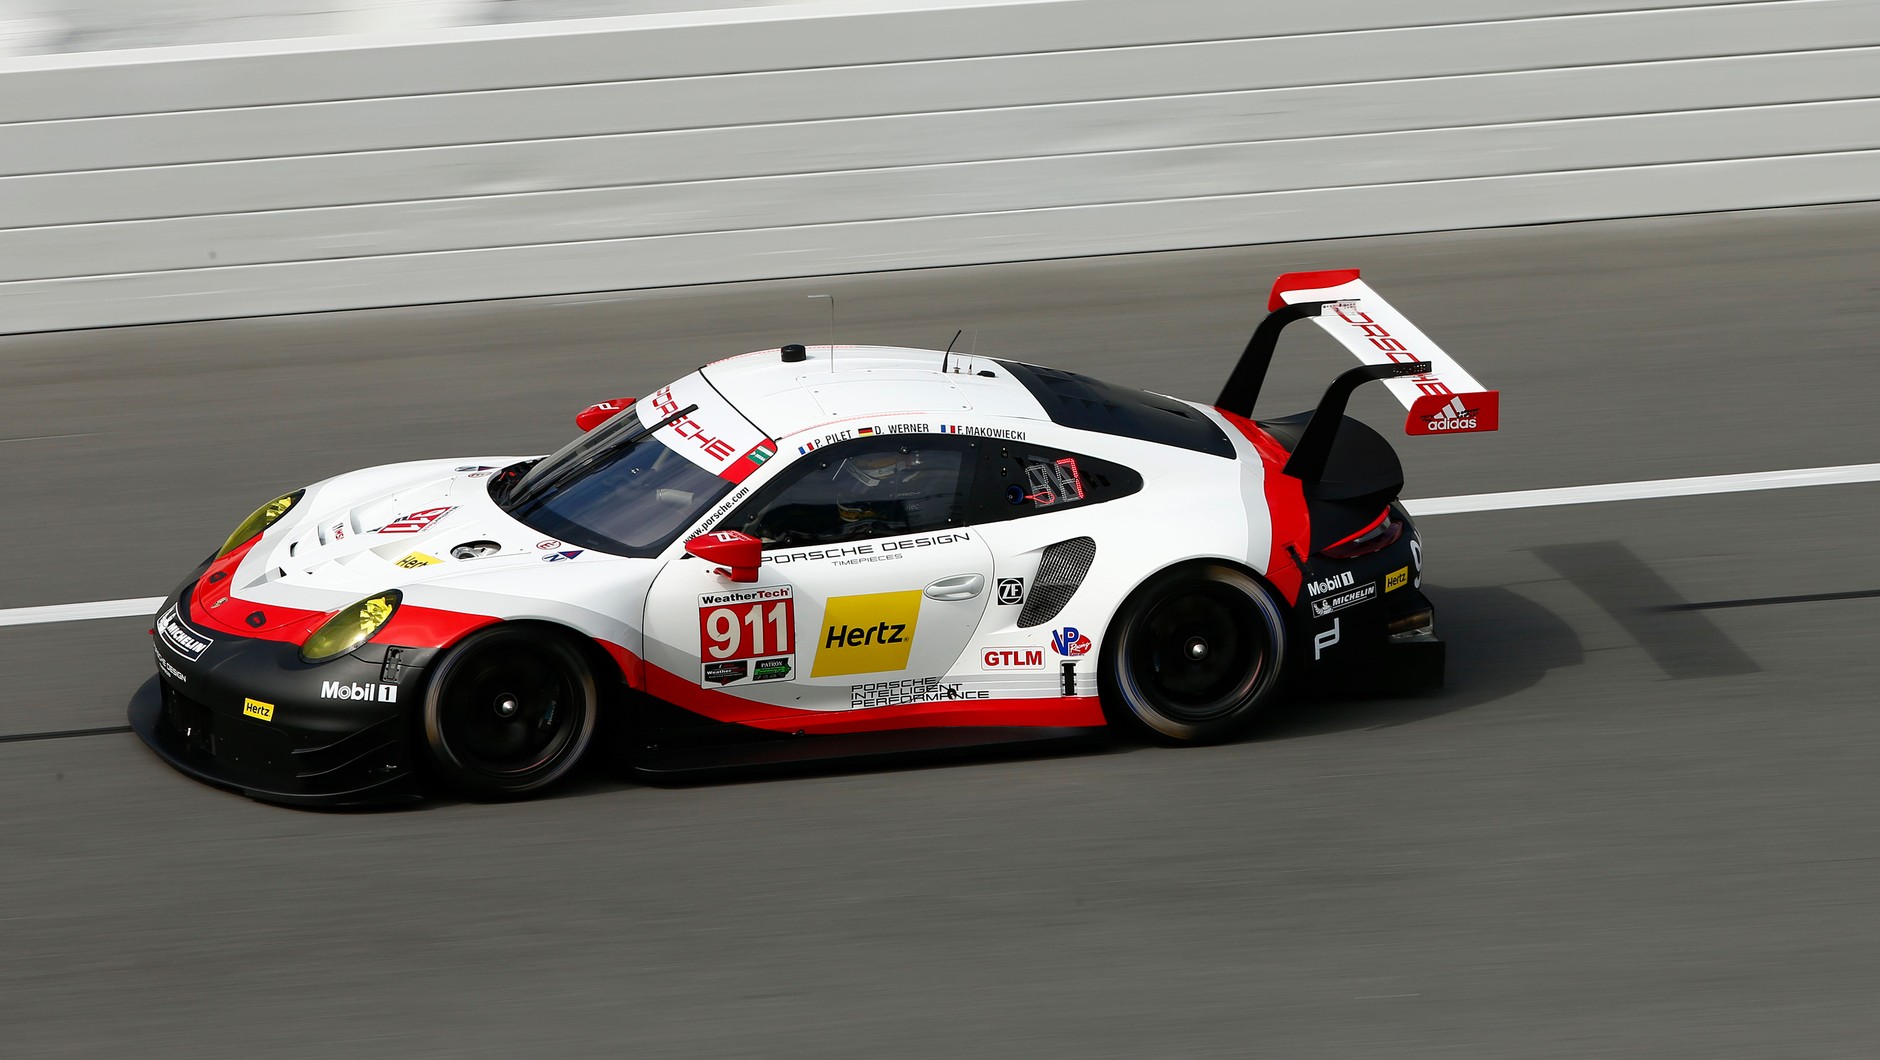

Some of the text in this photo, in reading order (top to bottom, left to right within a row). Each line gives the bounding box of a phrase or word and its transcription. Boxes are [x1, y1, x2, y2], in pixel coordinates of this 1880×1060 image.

[874, 423, 930, 435] D. WERNER
[1428, 417, 1477, 431] adidas
[814, 430, 852, 448] P. PILET
[761, 532, 970, 564] PORSCHE DESIGN
[831, 553, 903, 567] TIMEPIECES
[1307, 574, 1342, 597] Mobil
[1387, 572, 1406, 588] Hertz
[702, 588, 788, 605] WeatherTech
[1000, 583, 1019, 600] ZF
[1332, 586, 1375, 606] MICHELIN
[167, 622, 207, 653] MICHELIN
[706, 602, 788, 659] 911
[826, 622, 906, 649] Hertz
[1052, 627, 1092, 656] VP Racing
[984, 650, 1042, 666] GTLM
[320, 680, 376, 702] Mobil
[851, 676, 937, 692] PORSCHE
[851, 683, 963, 700] INTELLIGENT
[246, 702, 270, 717] Hertz
